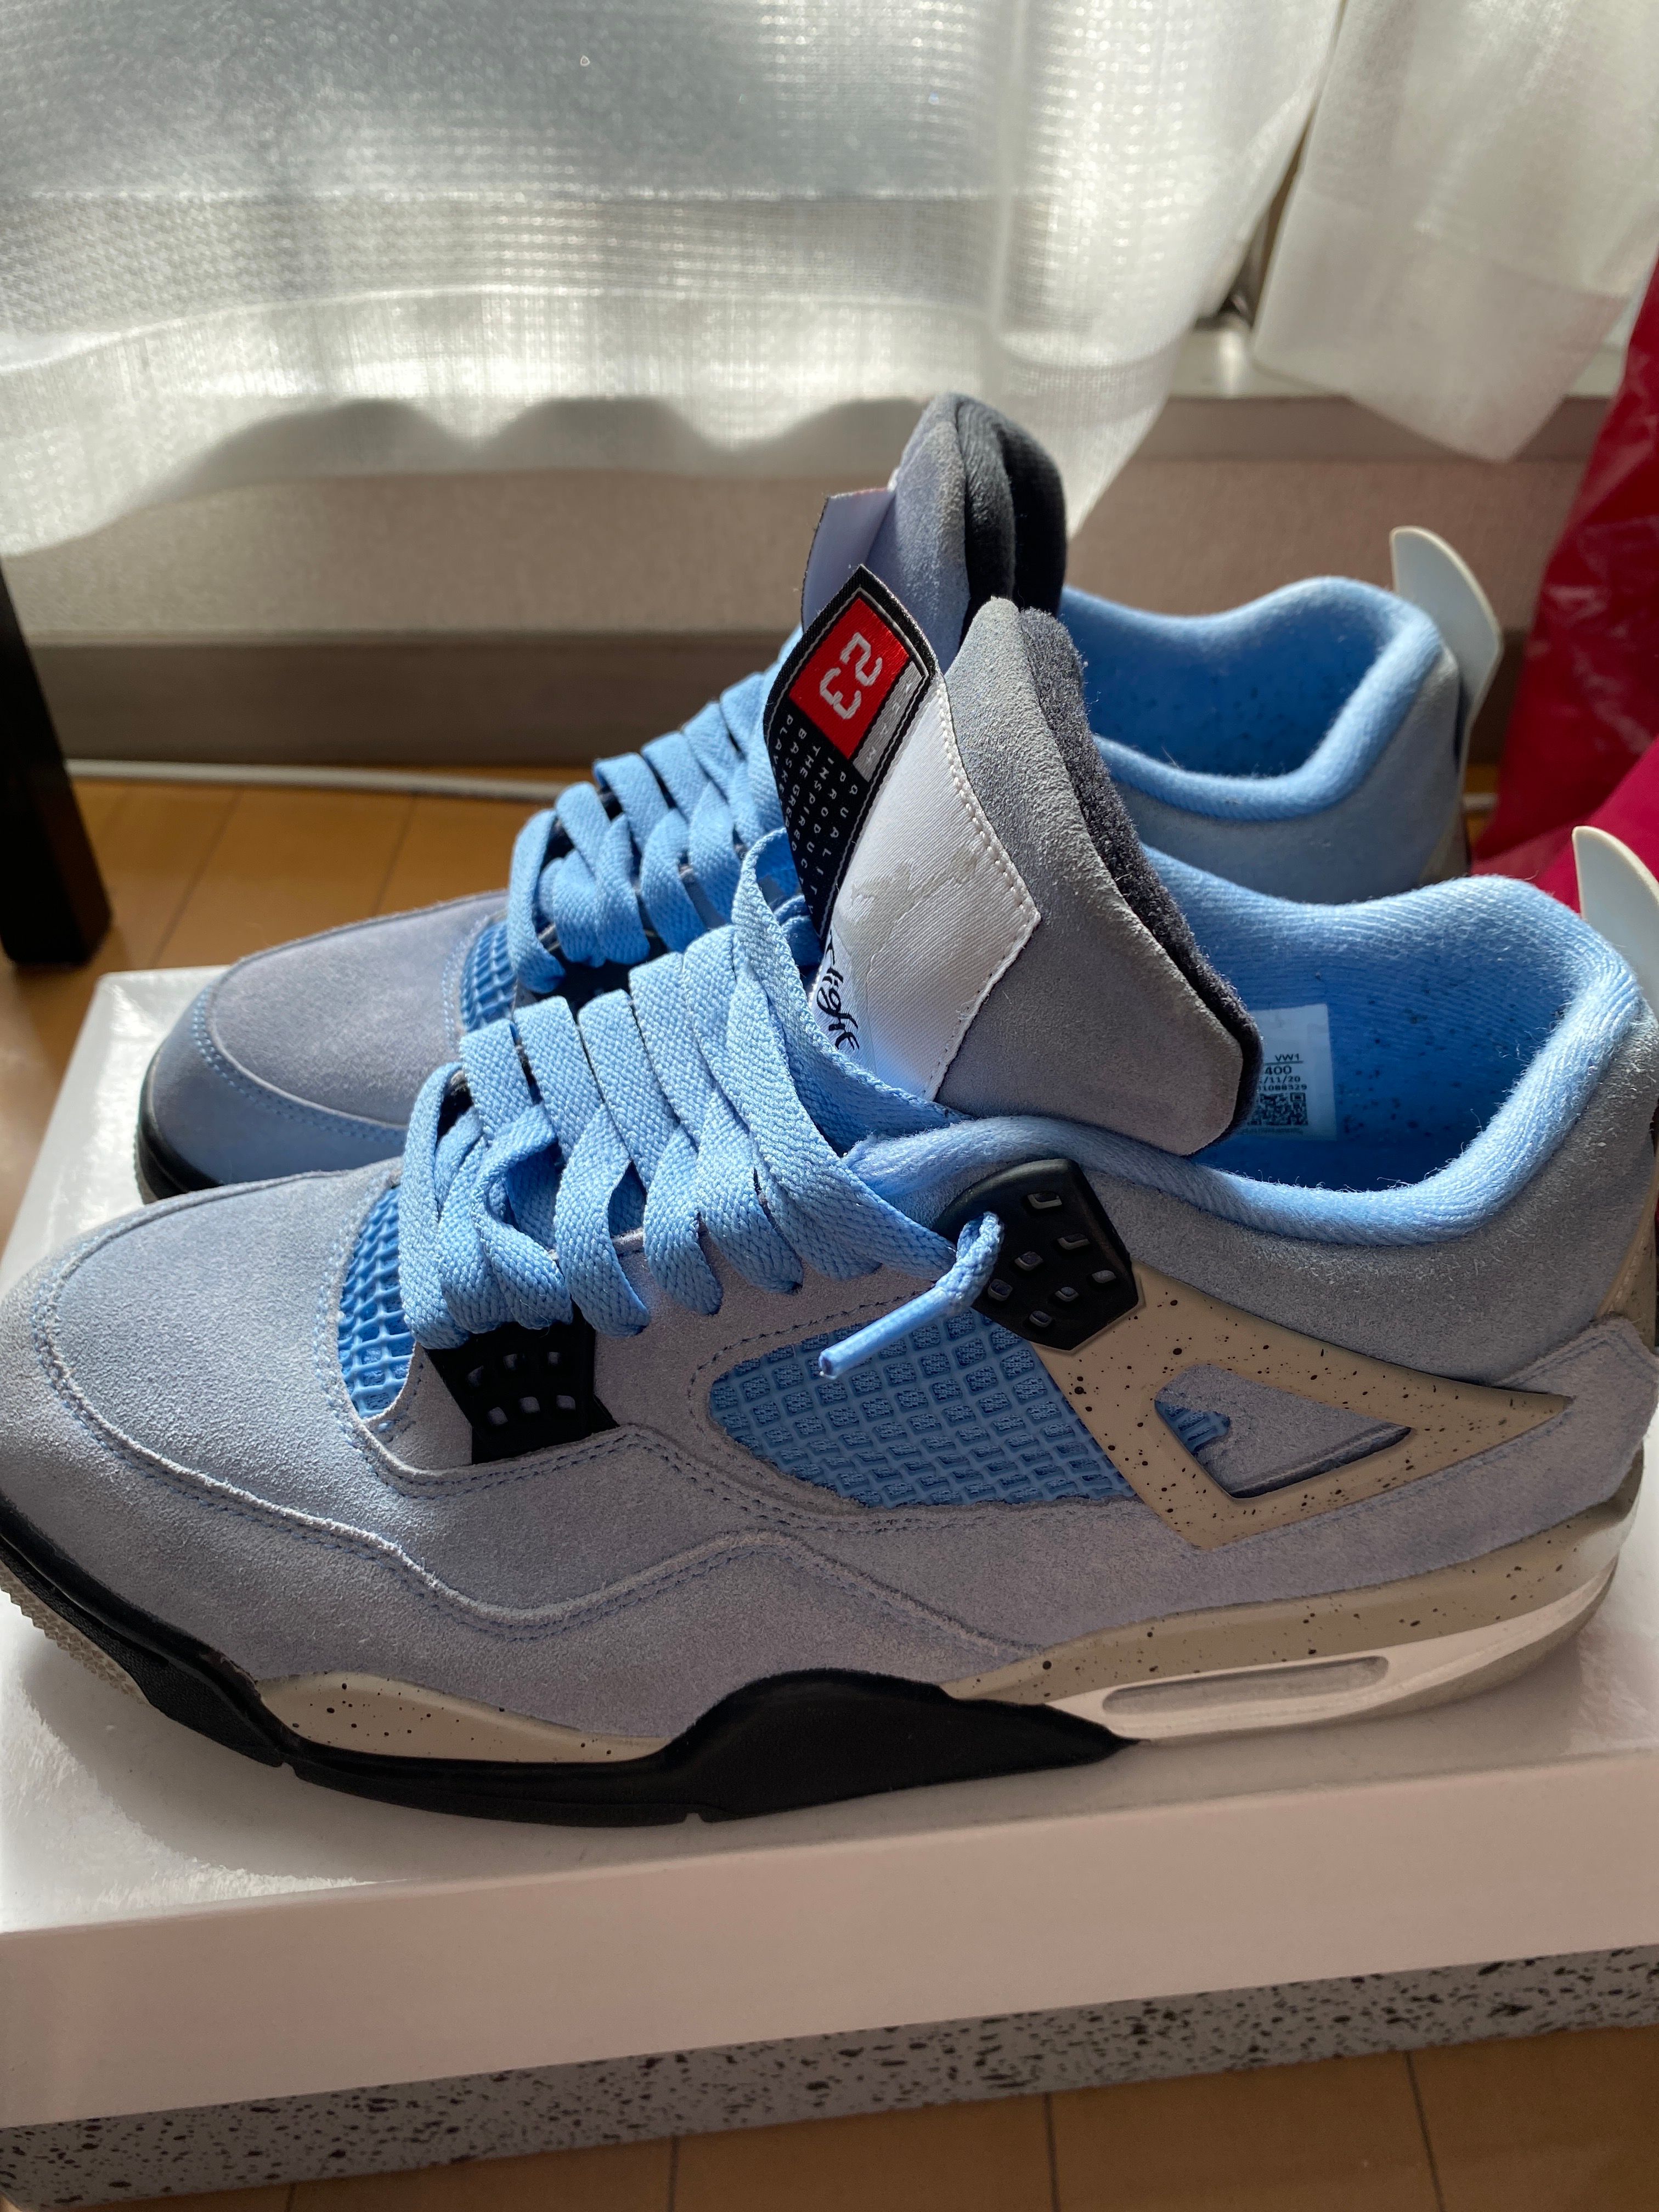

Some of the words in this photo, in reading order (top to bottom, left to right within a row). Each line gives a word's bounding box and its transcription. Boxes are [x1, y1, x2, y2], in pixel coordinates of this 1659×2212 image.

[820, 632, 882, 720] 23
[799, 746, 821, 779] THE
[865, 681, 913, 765] TEAM
[792, 757, 834, 851] INSPIRED
[799, 771, 847, 884] PRODUCT
[808, 784, 858, 915] QUALITY
[1264, 1065, 1292, 1075] 400
